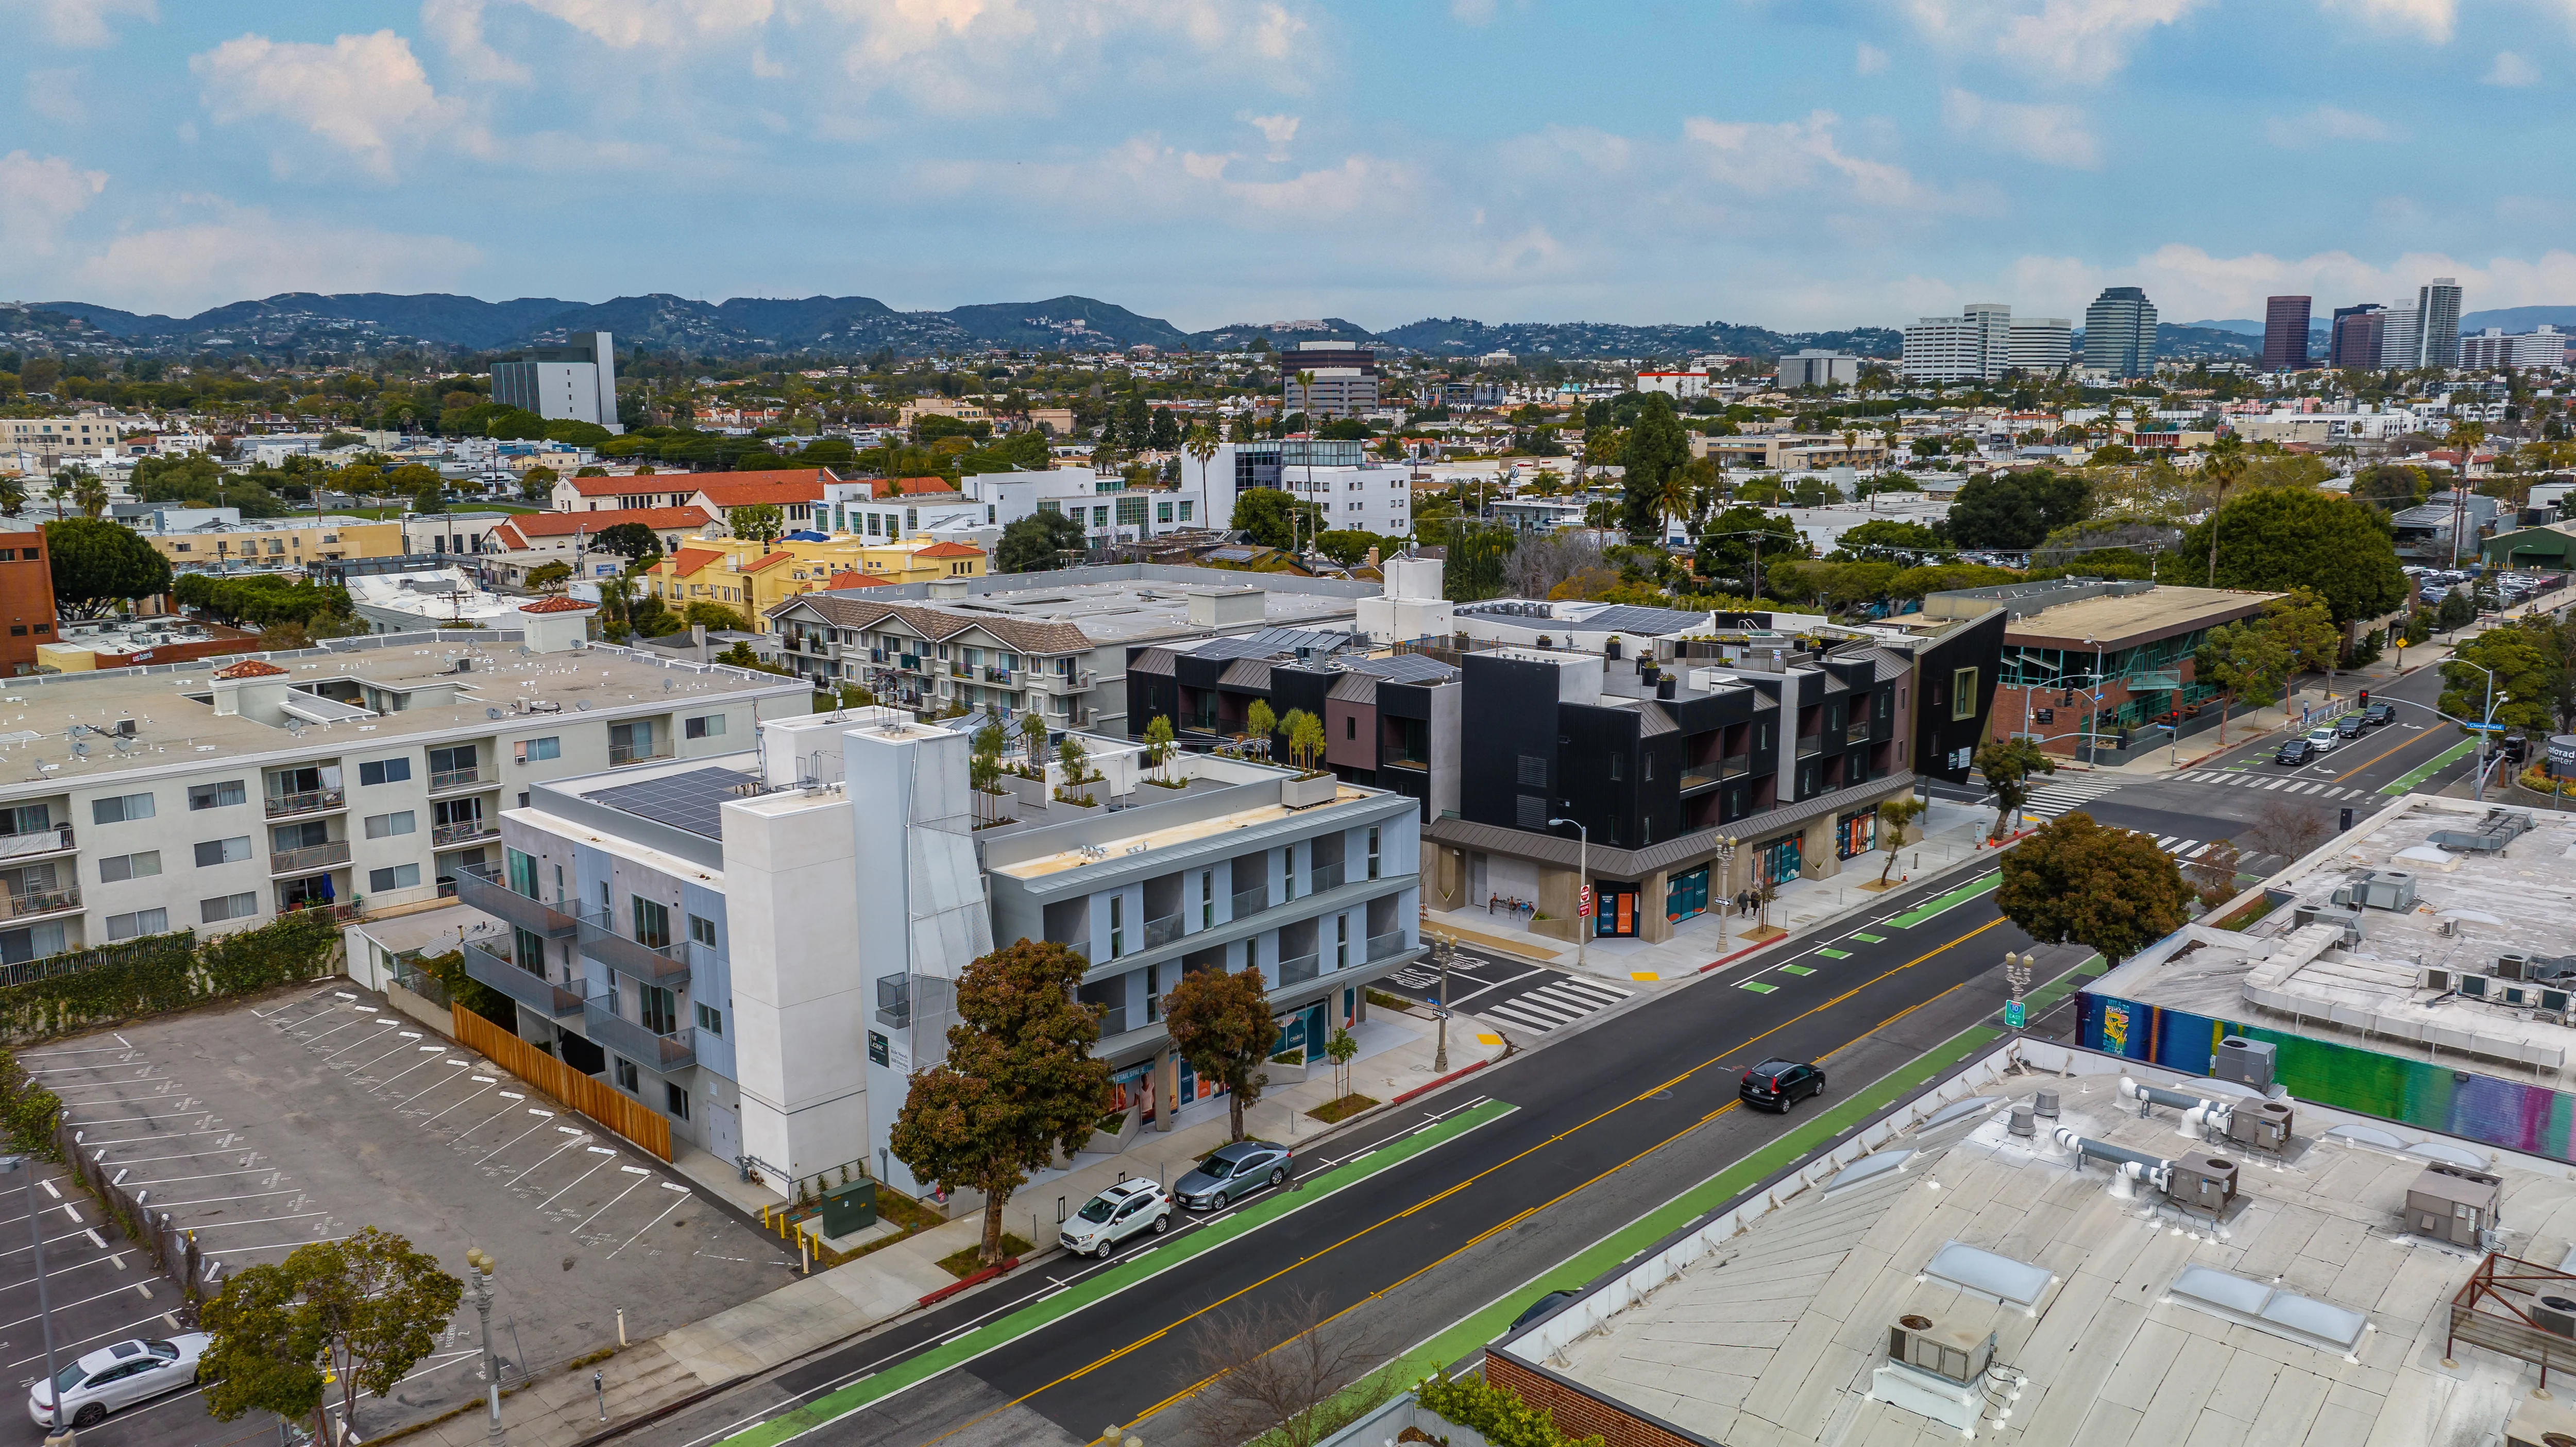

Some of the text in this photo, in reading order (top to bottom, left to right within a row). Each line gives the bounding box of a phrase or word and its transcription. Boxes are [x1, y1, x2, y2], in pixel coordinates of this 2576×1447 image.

[2548, 746, 2576, 758] colorad
[2549, 755, 2574, 765] center
[869, 1031, 877, 1041] For
[870, 1039, 884, 1051] Lease
[1112, 1072, 1129, 1083] RETAIL
[1130, 1067, 1145, 1078] SPACE
[445, 1324, 457, 1348] RESERVED
[18, 1376, 37, 1388] 20
